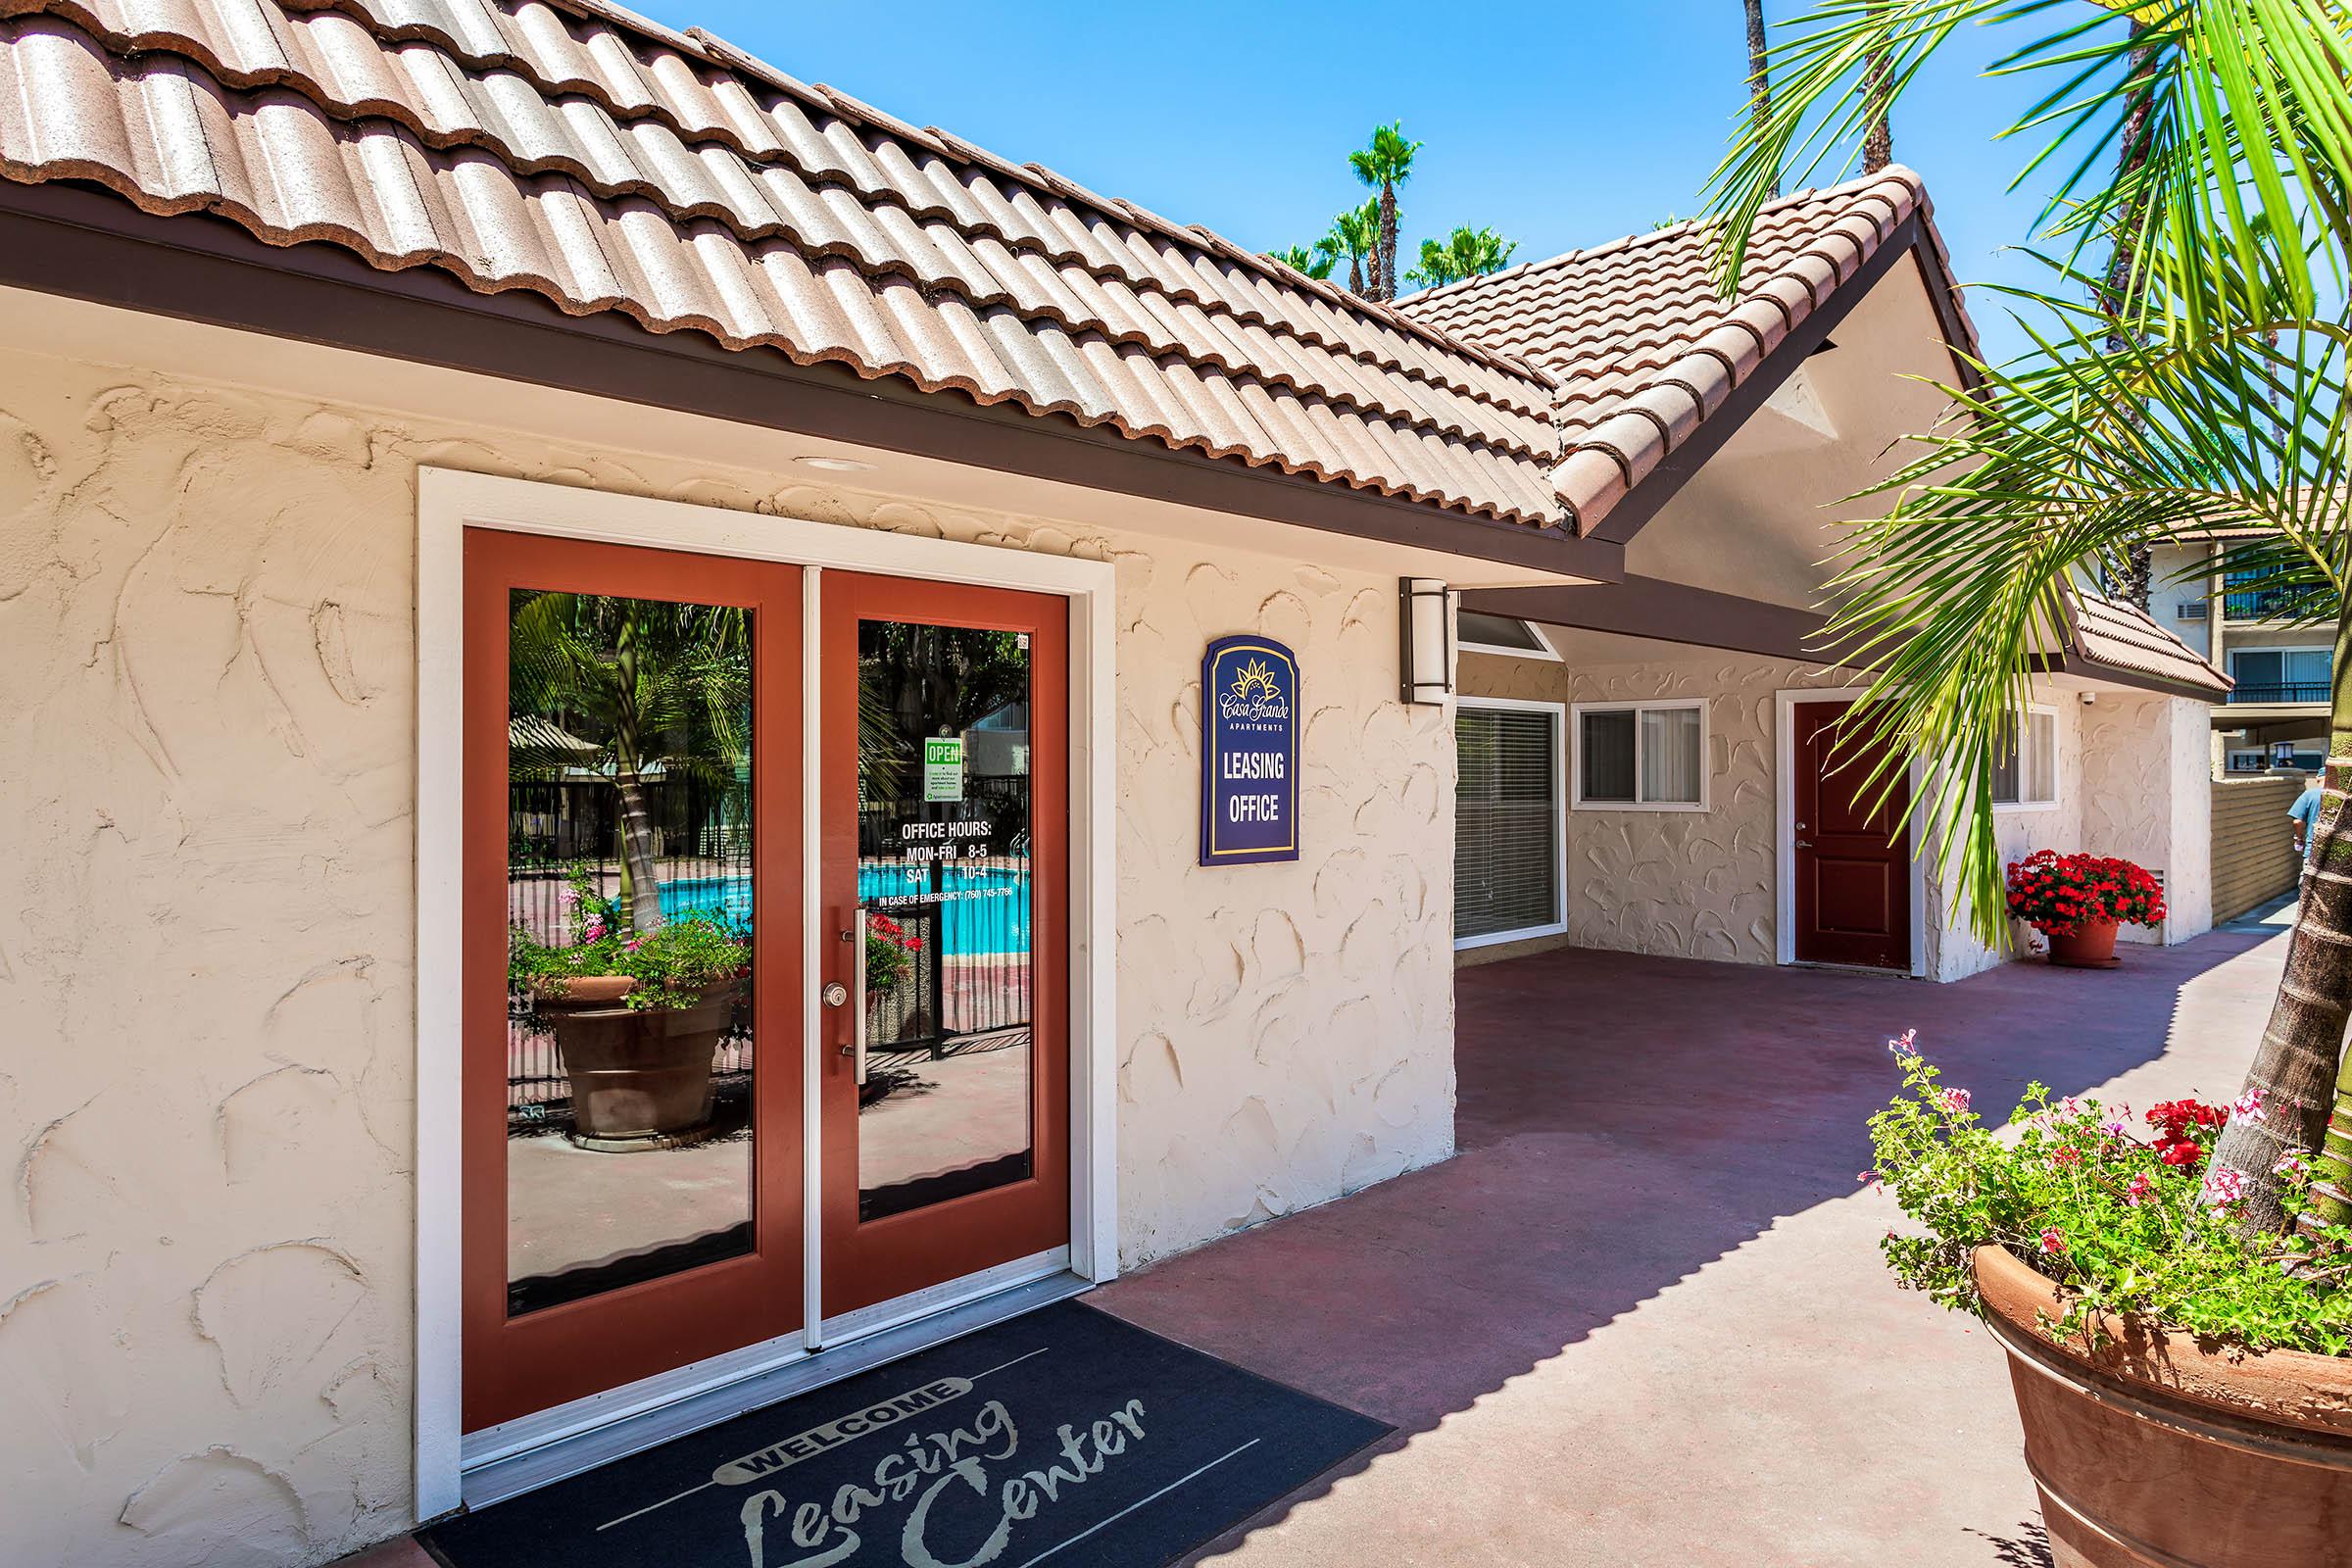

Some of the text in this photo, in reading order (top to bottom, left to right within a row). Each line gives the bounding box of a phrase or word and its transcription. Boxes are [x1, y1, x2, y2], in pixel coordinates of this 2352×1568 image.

[1219, 692, 1289, 721] Casa Grande
[1229, 722, 1283, 732] APARTMENTS
[929, 746, 958, 762] OPEN
[1223, 752, 1284, 780] LEASING
[1229, 795, 1279, 823] OFFICE
[902, 820, 992, 840] OFFICE HOURS:
[906, 844, 988, 862] MON-FRI 8-5
[906, 864, 988, 883] SAT 10-4
[878, 897, 888, 907] IN
[888, 896, 908, 906] CASE
[908, 895, 919, 905] OF
[919, 891, 963, 903] EMERGENCY:
[964, 890, 981, 901] (760)
[735, 1382, 962, 1475] WELCOME
[740, 1399, 1019, 1568] Leasing
[901, 1398, 1148, 1568] Center
